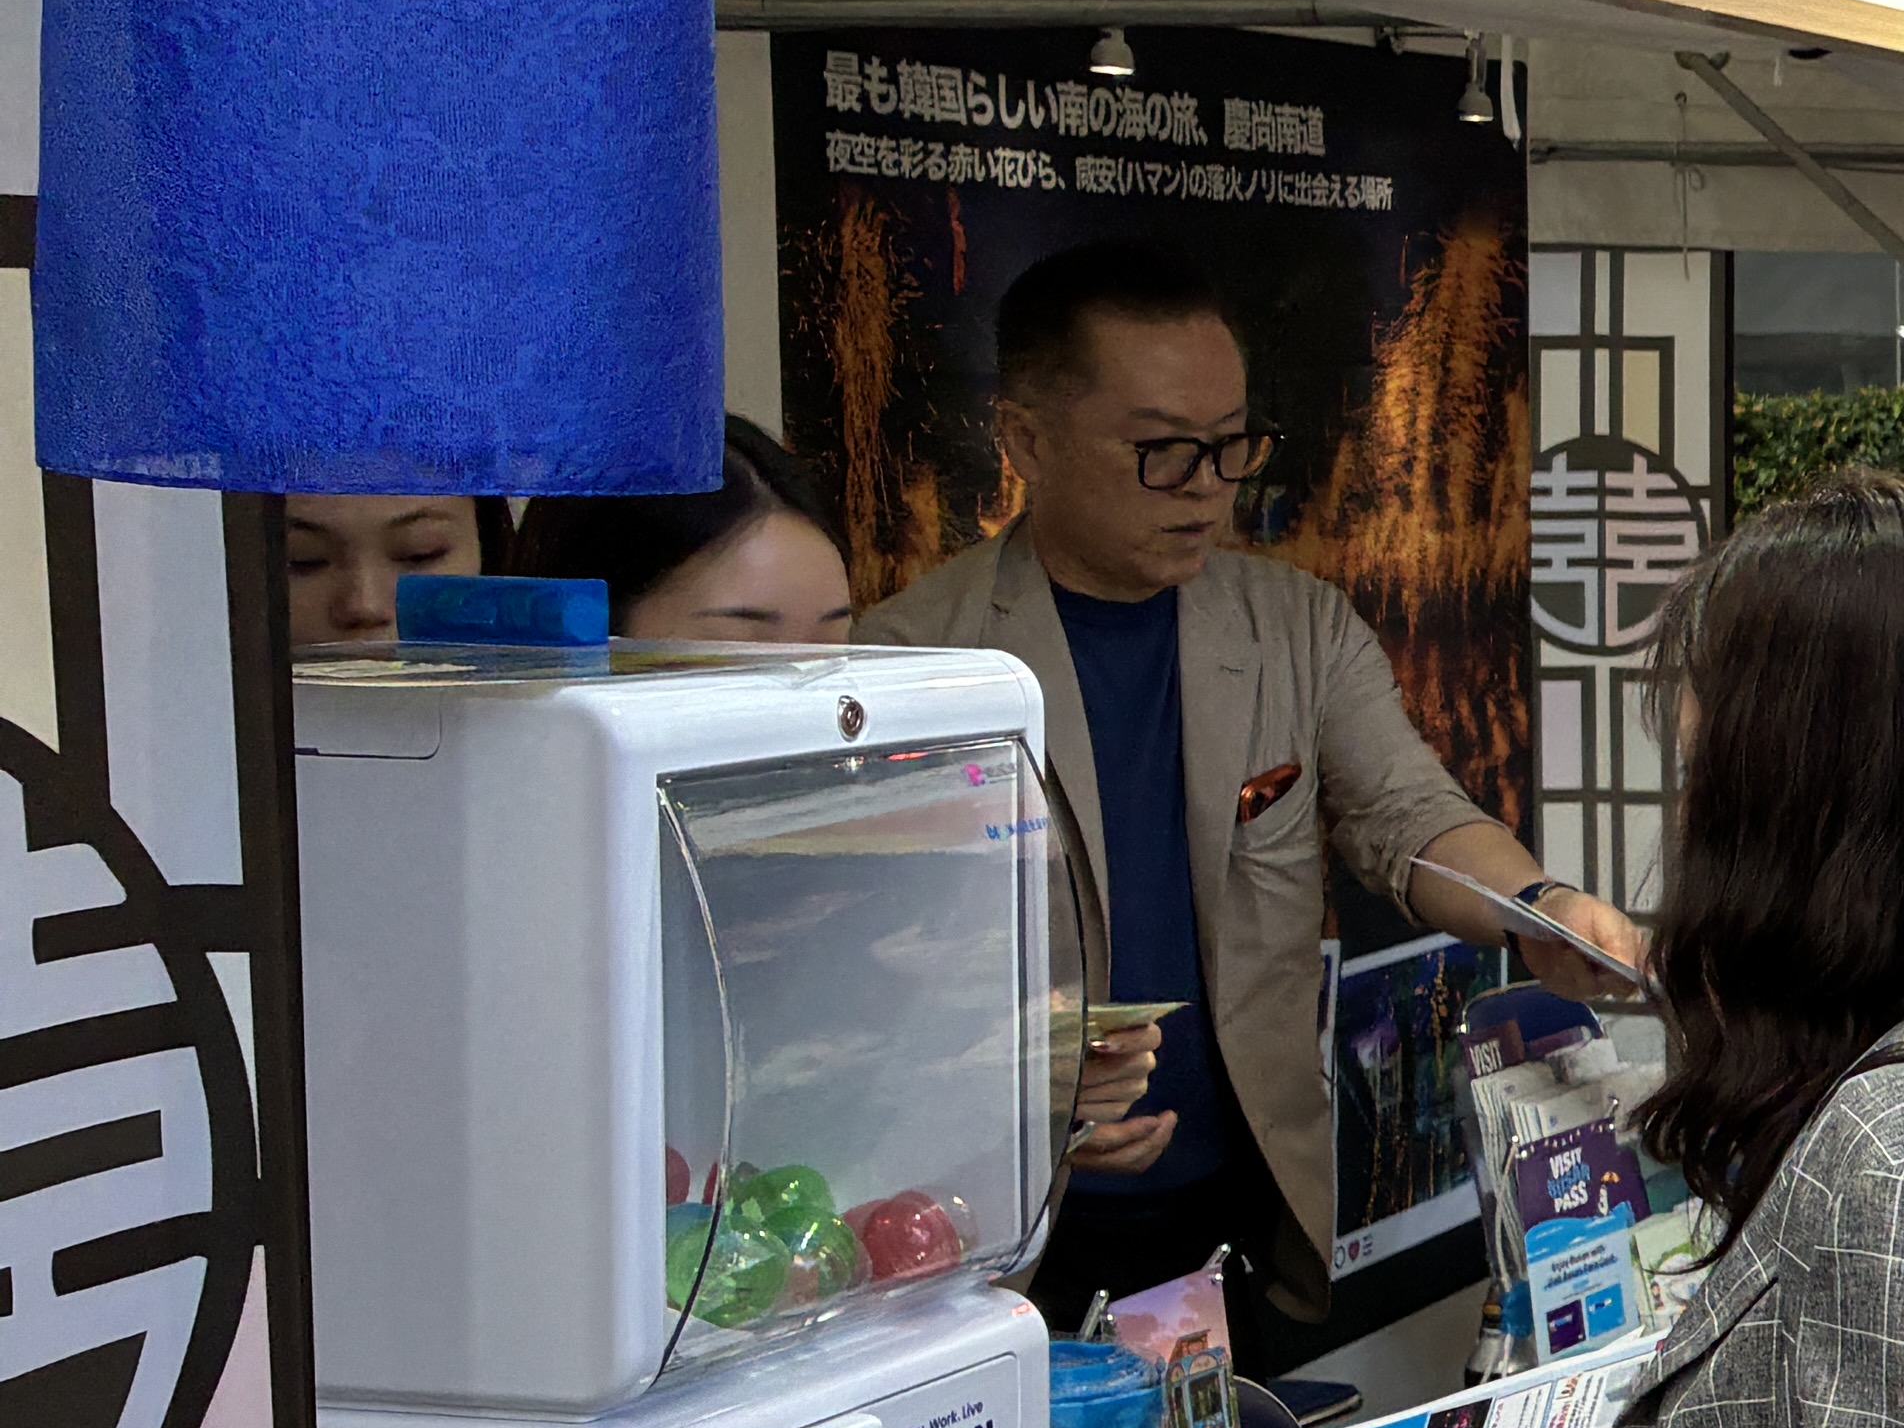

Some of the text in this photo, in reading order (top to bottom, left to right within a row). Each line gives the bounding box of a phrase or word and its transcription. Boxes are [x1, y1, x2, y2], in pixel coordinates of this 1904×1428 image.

[1469, 1039, 1503, 1077] VISIT
[1549, 1146, 1584, 1180] VISIT
[1554, 1179, 1589, 1214] PASS
[962, 1401, 984, 1419] Live
